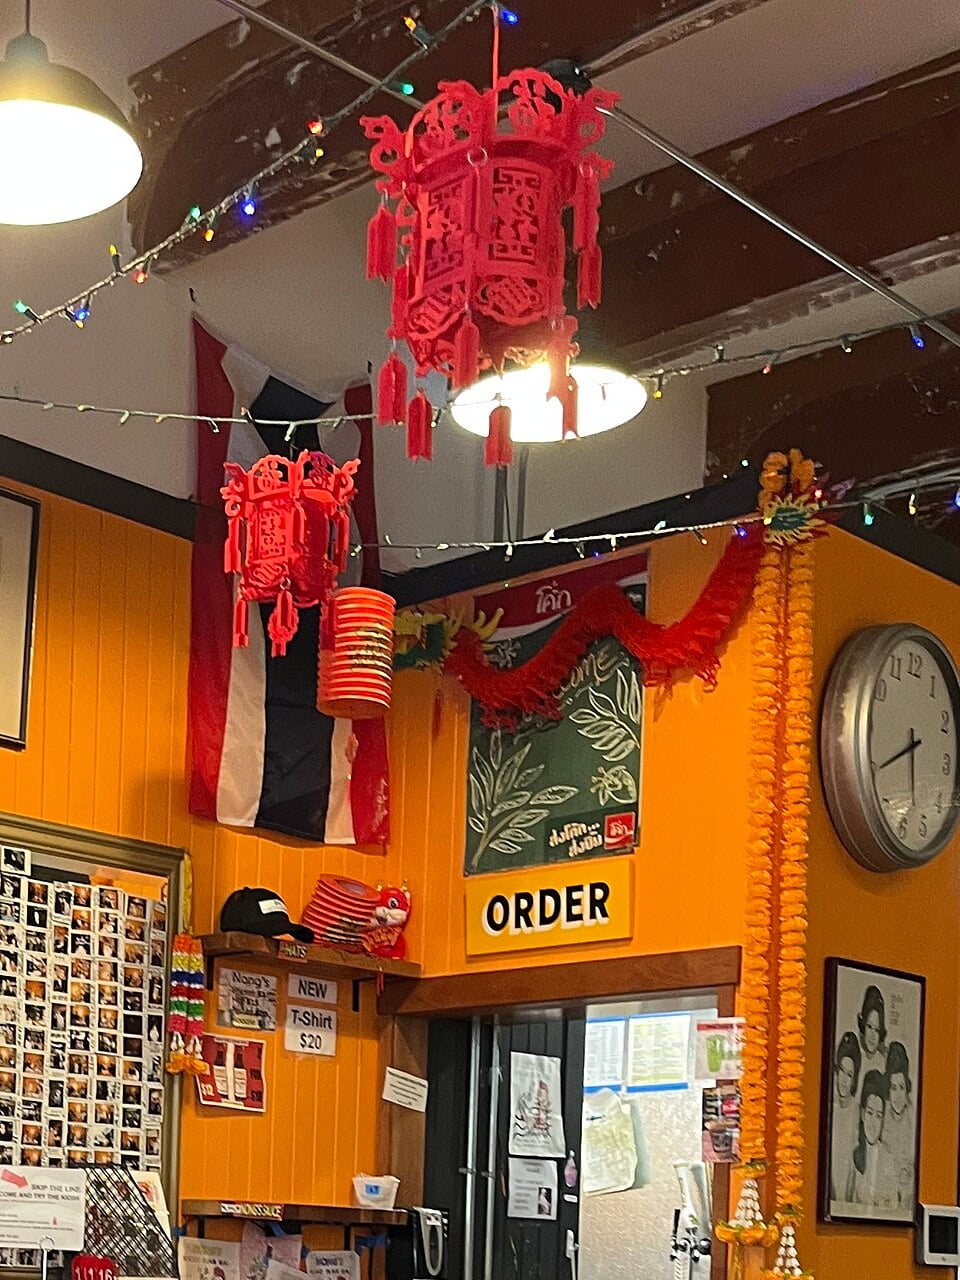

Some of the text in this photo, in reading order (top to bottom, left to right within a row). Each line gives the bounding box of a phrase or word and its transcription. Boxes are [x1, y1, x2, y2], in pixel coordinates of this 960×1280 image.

[889, 654, 902, 681] 11
[907, 652, 922, 679] 12
[929, 675, 937, 699] 1
[941, 710, 950, 734] 2
[942, 753, 951, 776] 3
[919, 814, 927, 839] 5
[484, 881, 611, 934] ORDER
[298, 979, 328, 999] NEW
[291, 1008, 333, 1030] T-Shirt
[300, 1032, 323, 1050] $20
